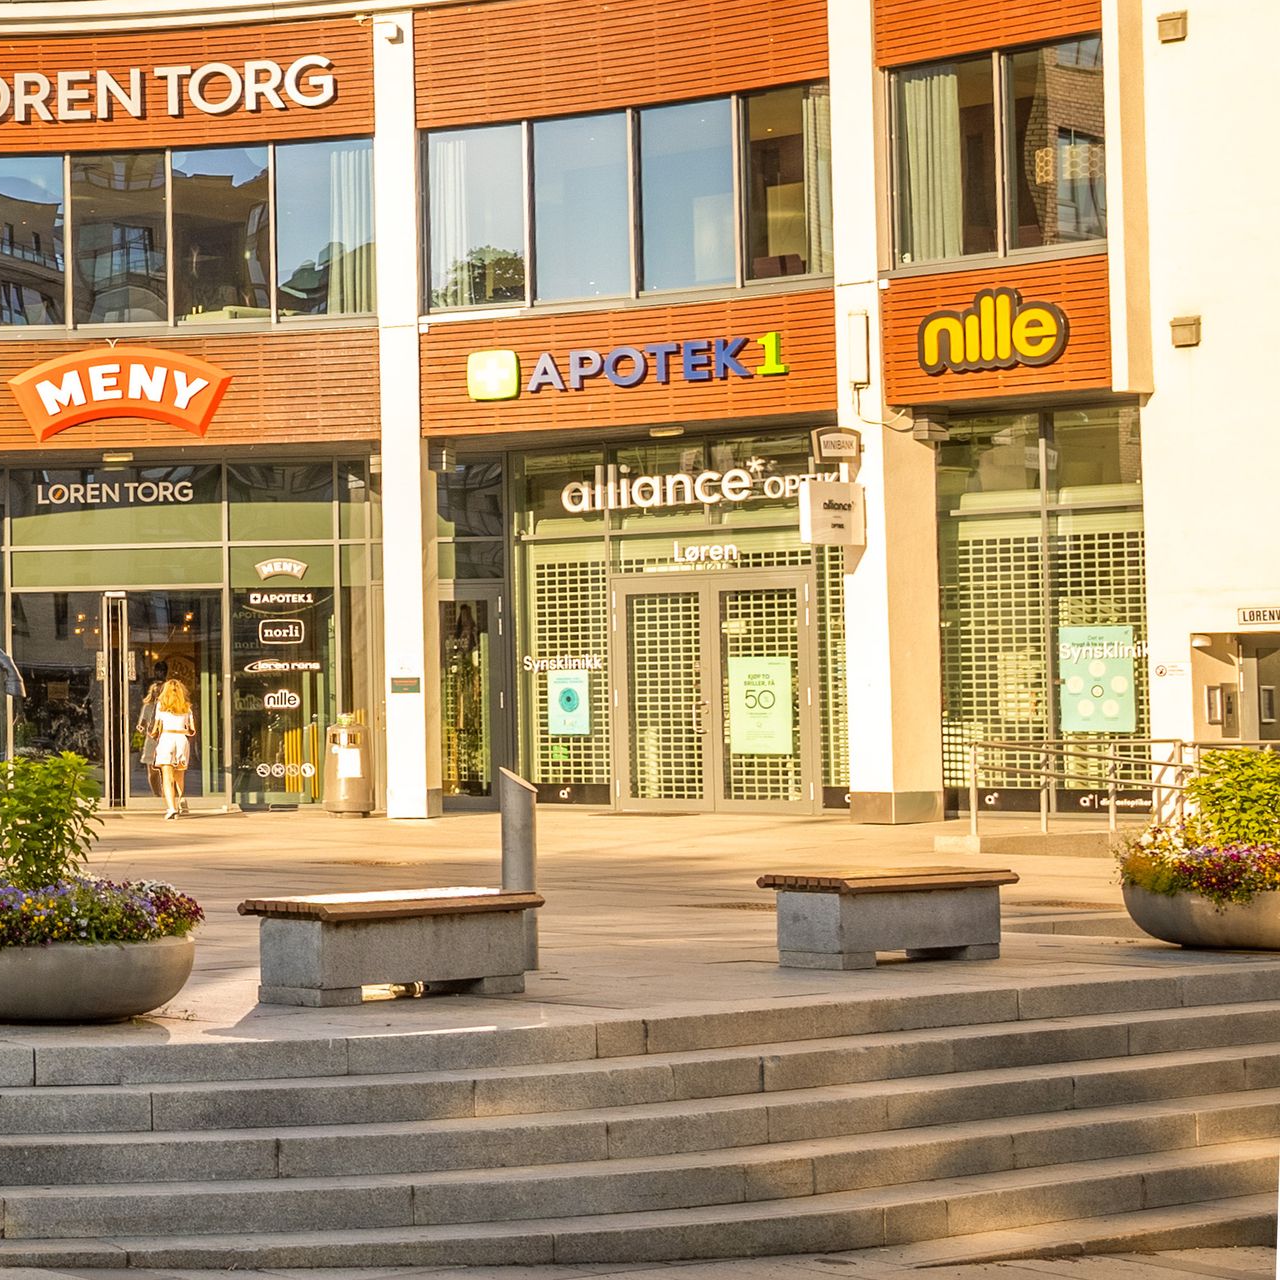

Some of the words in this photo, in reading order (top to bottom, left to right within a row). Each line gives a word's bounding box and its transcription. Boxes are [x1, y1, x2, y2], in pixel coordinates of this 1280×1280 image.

[153, 54, 338, 117] TORG
[923, 293, 1058, 366] nille
[35, 363, 210, 417] MENY
[822, 439, 855, 451] MINIBANK
[124, 480, 194, 503] TORG
[673, 540, 738, 563] Løren
[260, 561, 303, 576] MENY
[263, 625, 301, 638] norli
[523, 654, 603, 673] Synsklinikk
[267, 691, 298, 707] nille
